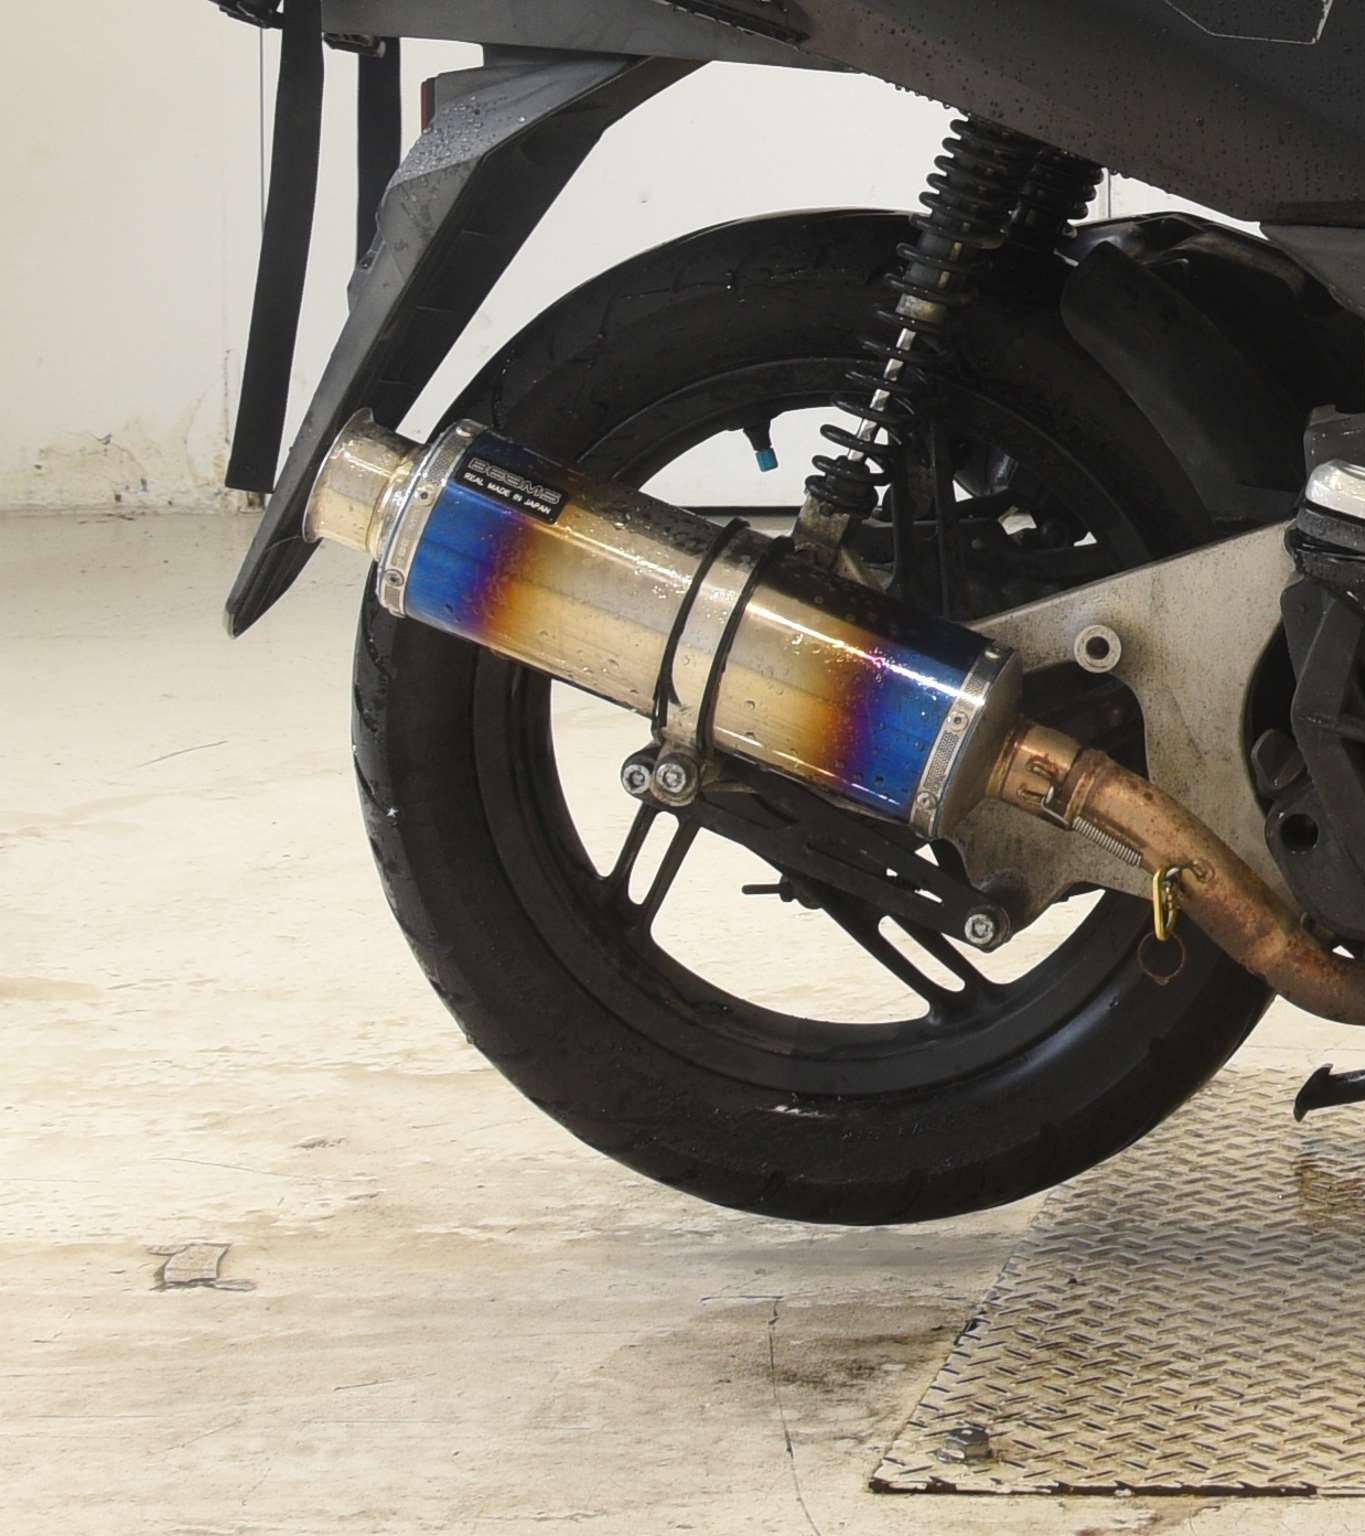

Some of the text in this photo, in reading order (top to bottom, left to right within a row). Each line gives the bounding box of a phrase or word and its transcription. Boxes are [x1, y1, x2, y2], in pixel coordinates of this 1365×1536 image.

[463, 472, 552, 514] REAL MADE IN JAPAN
